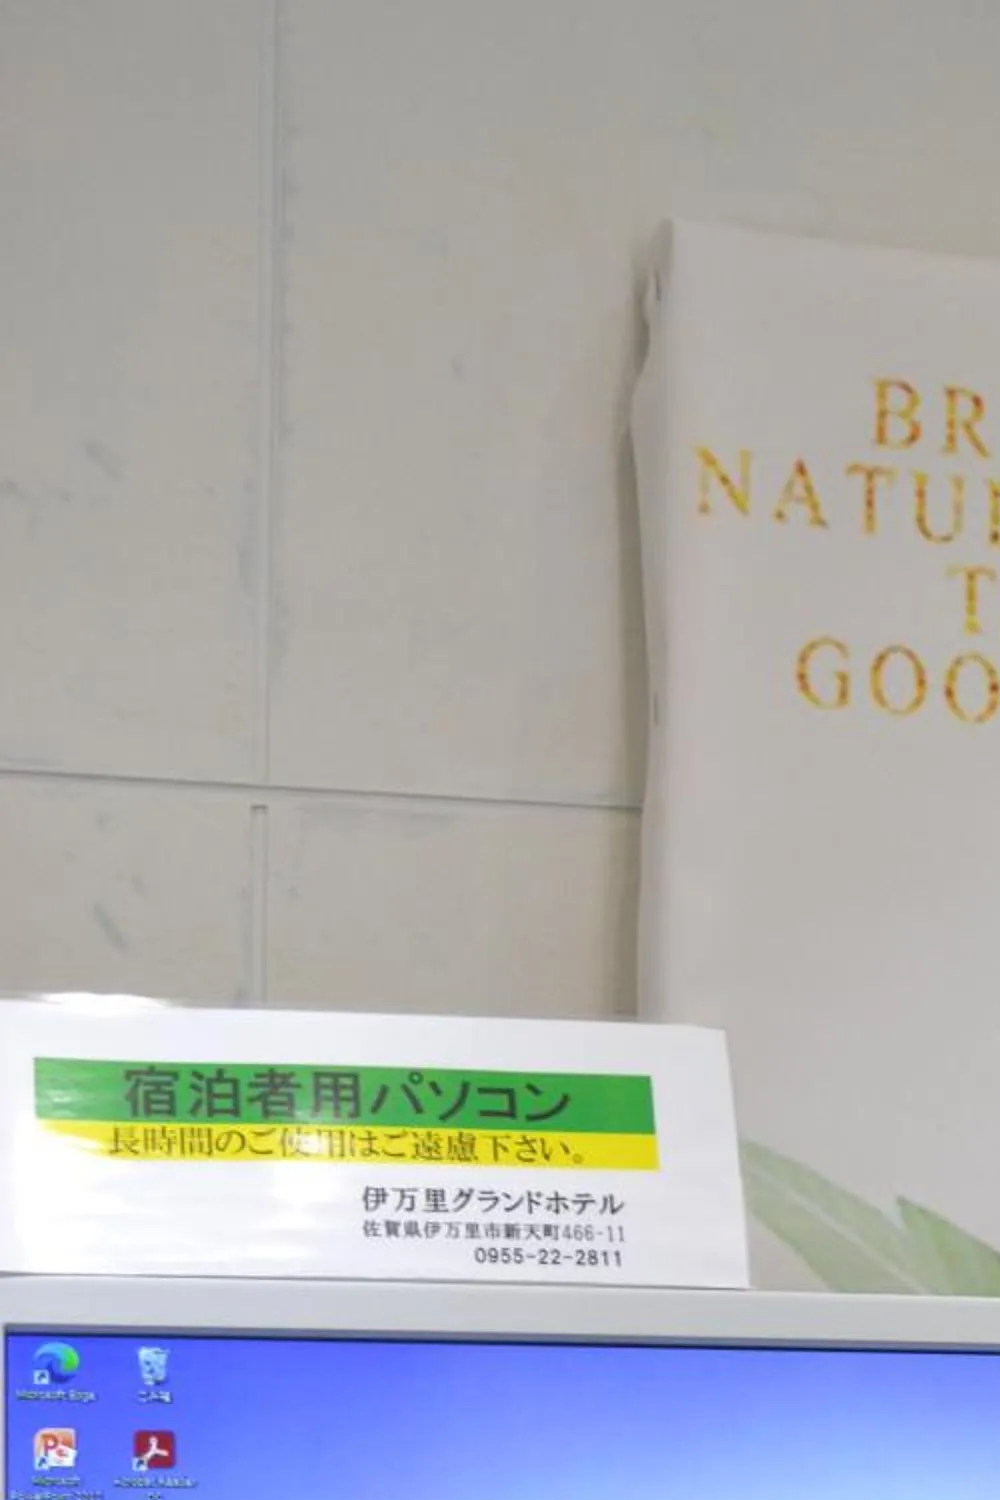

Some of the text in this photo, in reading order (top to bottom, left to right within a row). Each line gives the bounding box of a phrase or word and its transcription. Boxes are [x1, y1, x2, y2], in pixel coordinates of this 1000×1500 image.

[124, 1066, 572, 1124] 宿泊者用パソコン
[109, 1126, 587, 1165] 長時間のご使用はご遠慮下さい。
[362, 1184, 626, 1216] 伊万里グランドホテル
[474, 1247, 623, 1269] 0955-22-2811
